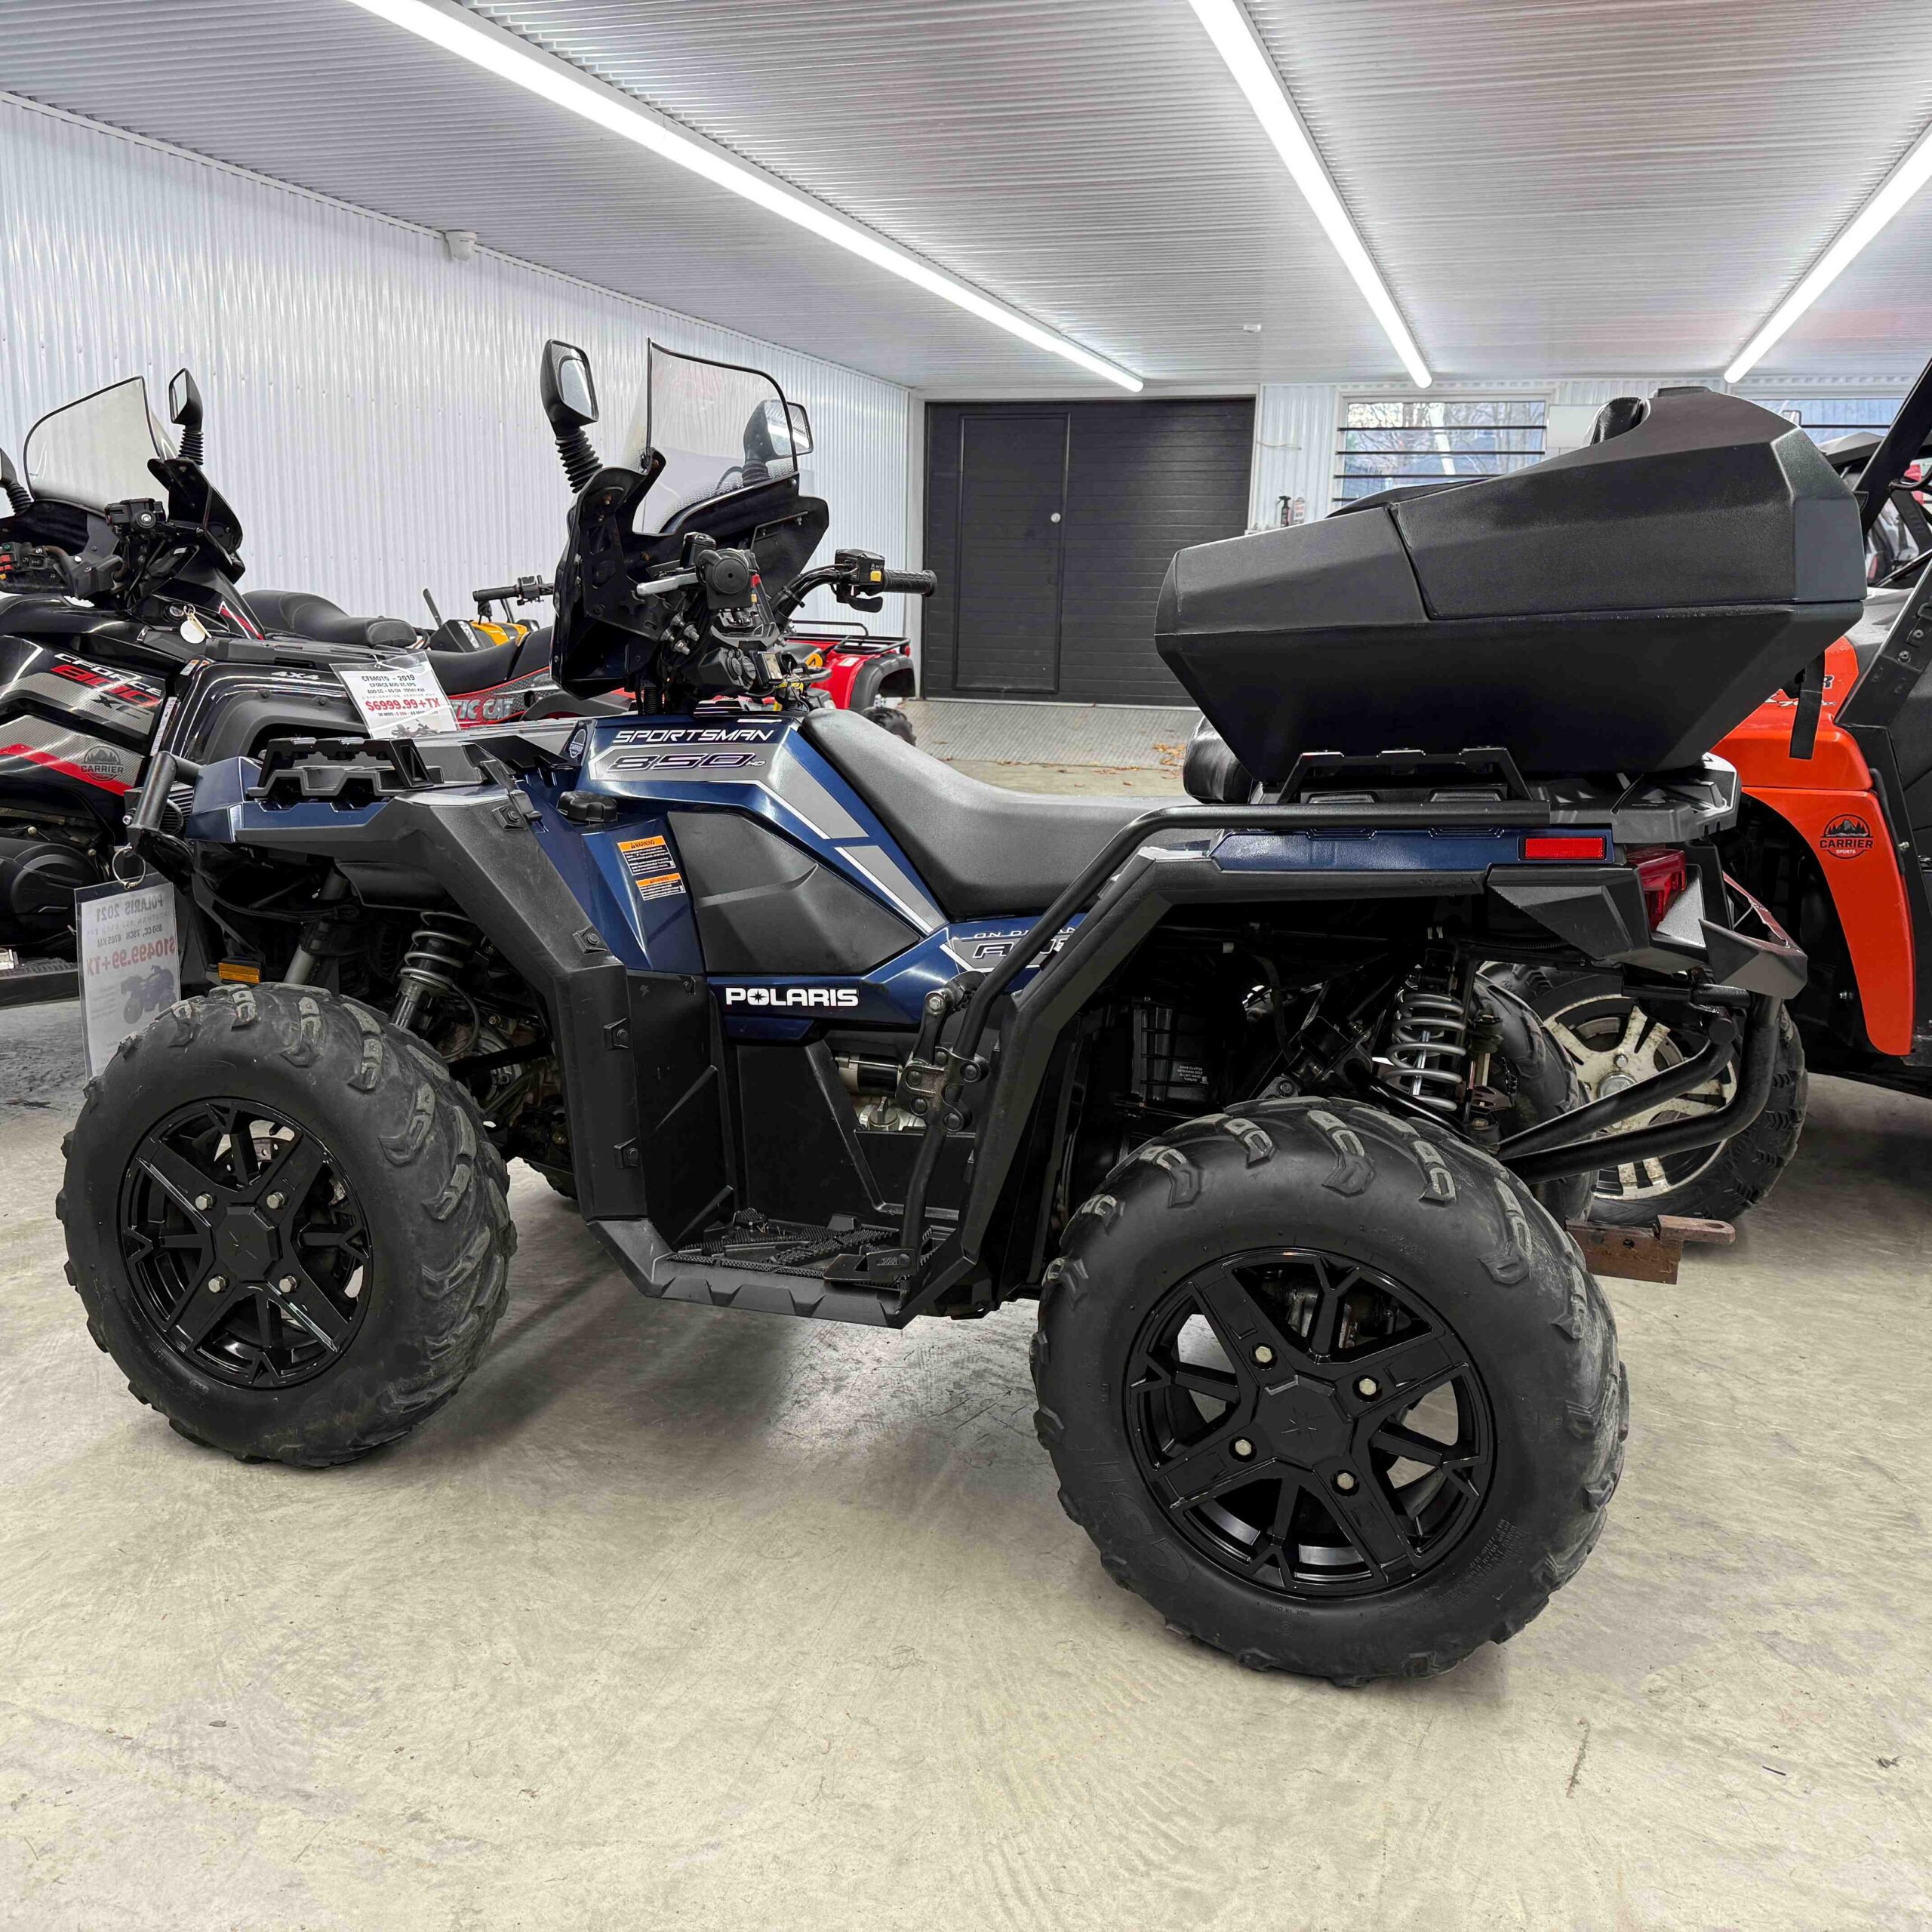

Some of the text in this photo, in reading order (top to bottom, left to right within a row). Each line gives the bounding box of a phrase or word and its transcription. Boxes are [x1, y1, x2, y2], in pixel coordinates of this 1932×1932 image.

[54, 653, 162, 697] CFORCE
[365, 697, 441, 712] $6999.99+TX
[451, 698, 515, 720] TIC CAT
[612, 729, 775, 743] SPORTSMAN
[81, 764, 124, 774] CARRIER
[608, 752, 755, 773] 850
[1820, 839, 1873, 848] CARRIER
[725, 987, 859, 1007] POLARIS
